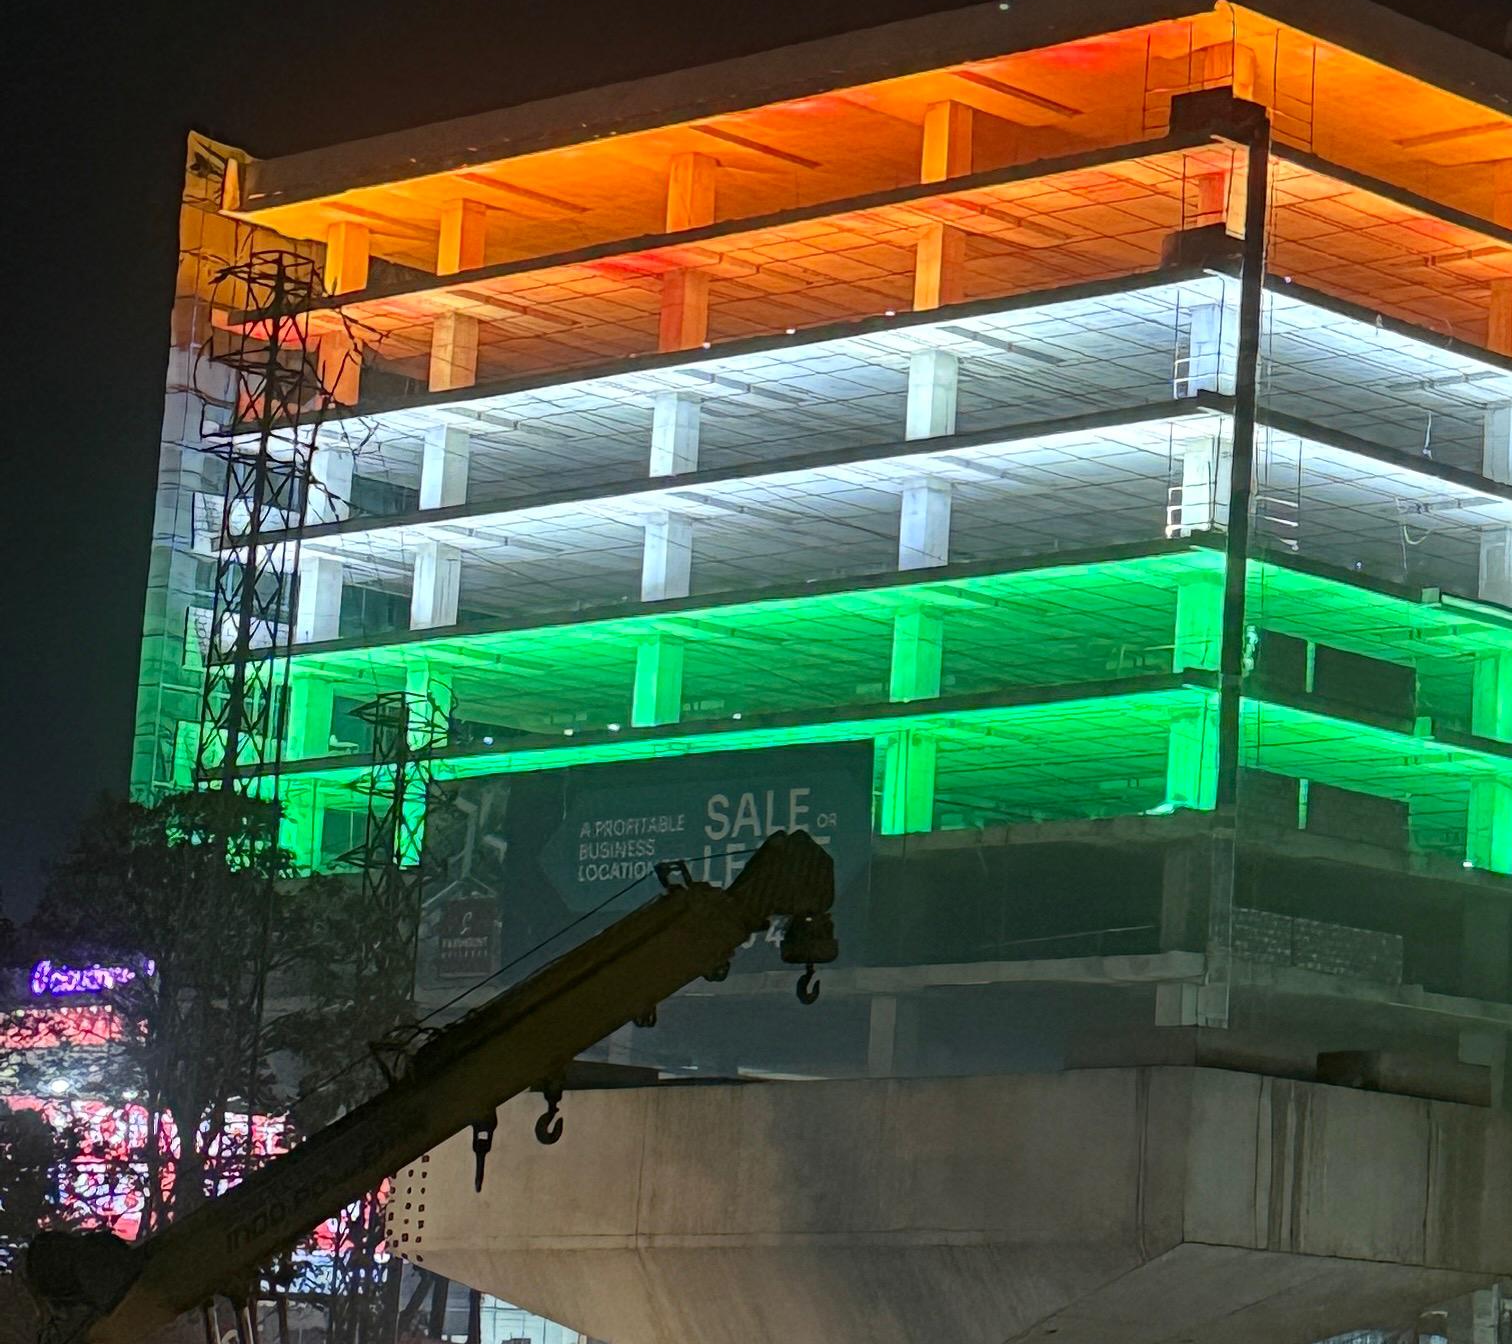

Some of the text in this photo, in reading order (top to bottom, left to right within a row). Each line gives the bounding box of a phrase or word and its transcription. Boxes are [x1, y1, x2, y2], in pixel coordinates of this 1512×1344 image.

[579, 814, 686, 838] A PROFITABLE
[703, 787, 838, 841] SALE OR
[578, 838, 656, 861] BUSINESS
